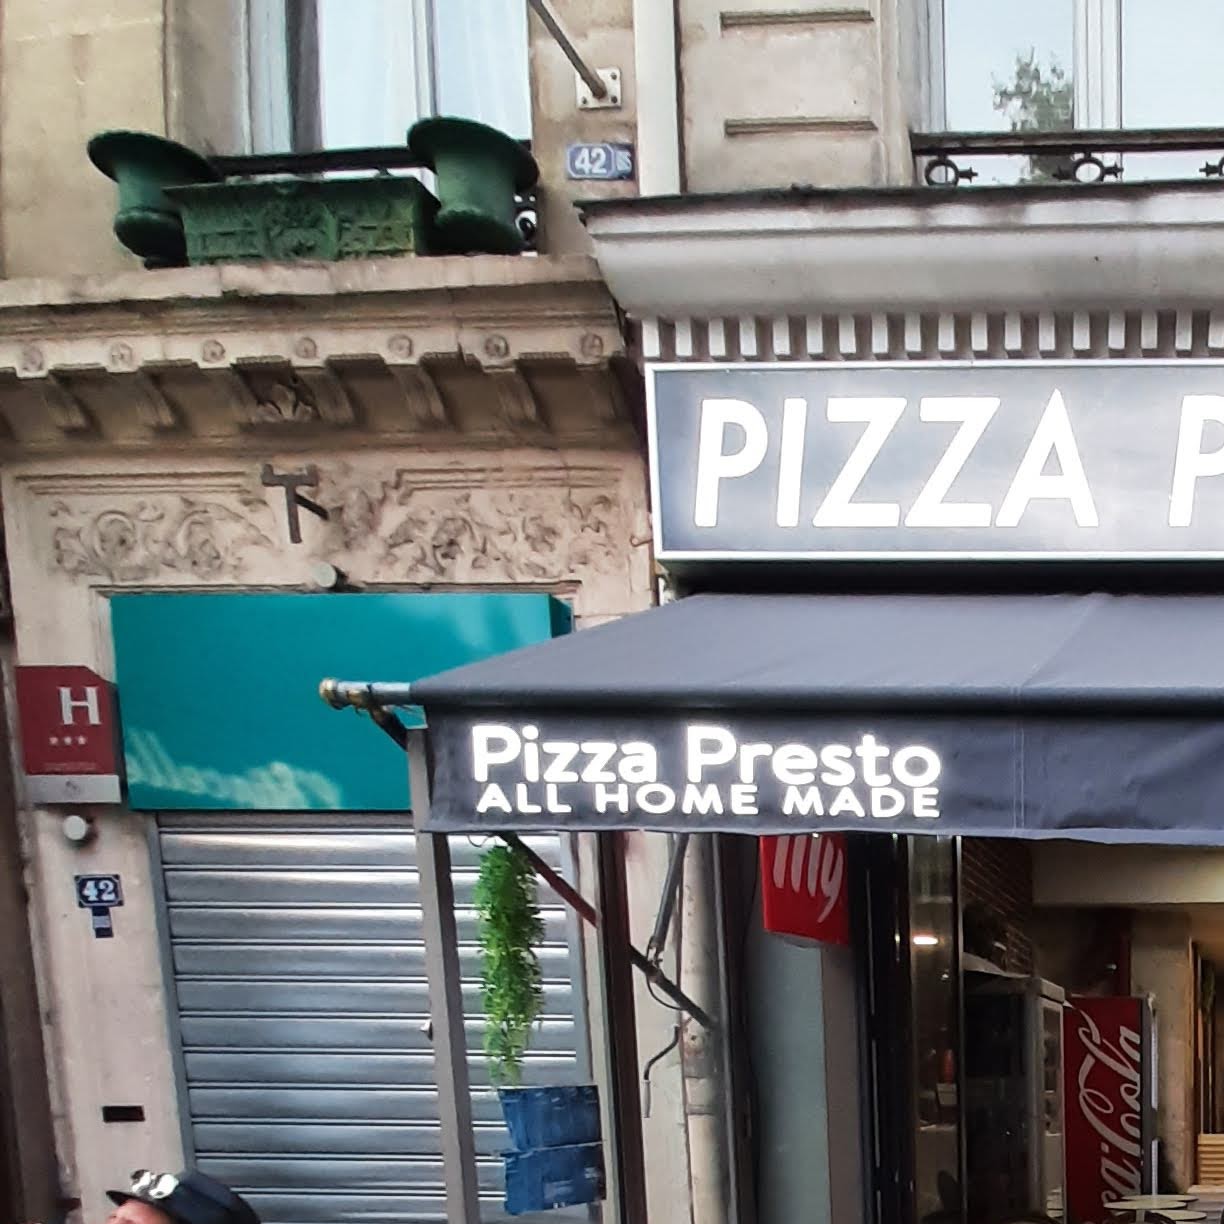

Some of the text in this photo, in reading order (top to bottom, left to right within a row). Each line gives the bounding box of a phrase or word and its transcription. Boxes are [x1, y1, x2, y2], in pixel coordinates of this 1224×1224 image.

[575, 147, 607, 174] 42
[694, 388, 1099, 528] PIZZA
[57, 685, 102, 726] H
[471, 724, 942, 787] Pizza Presto
[476, 783, 941, 818] ALL HOME MADE
[82, 880, 116, 901] 42
